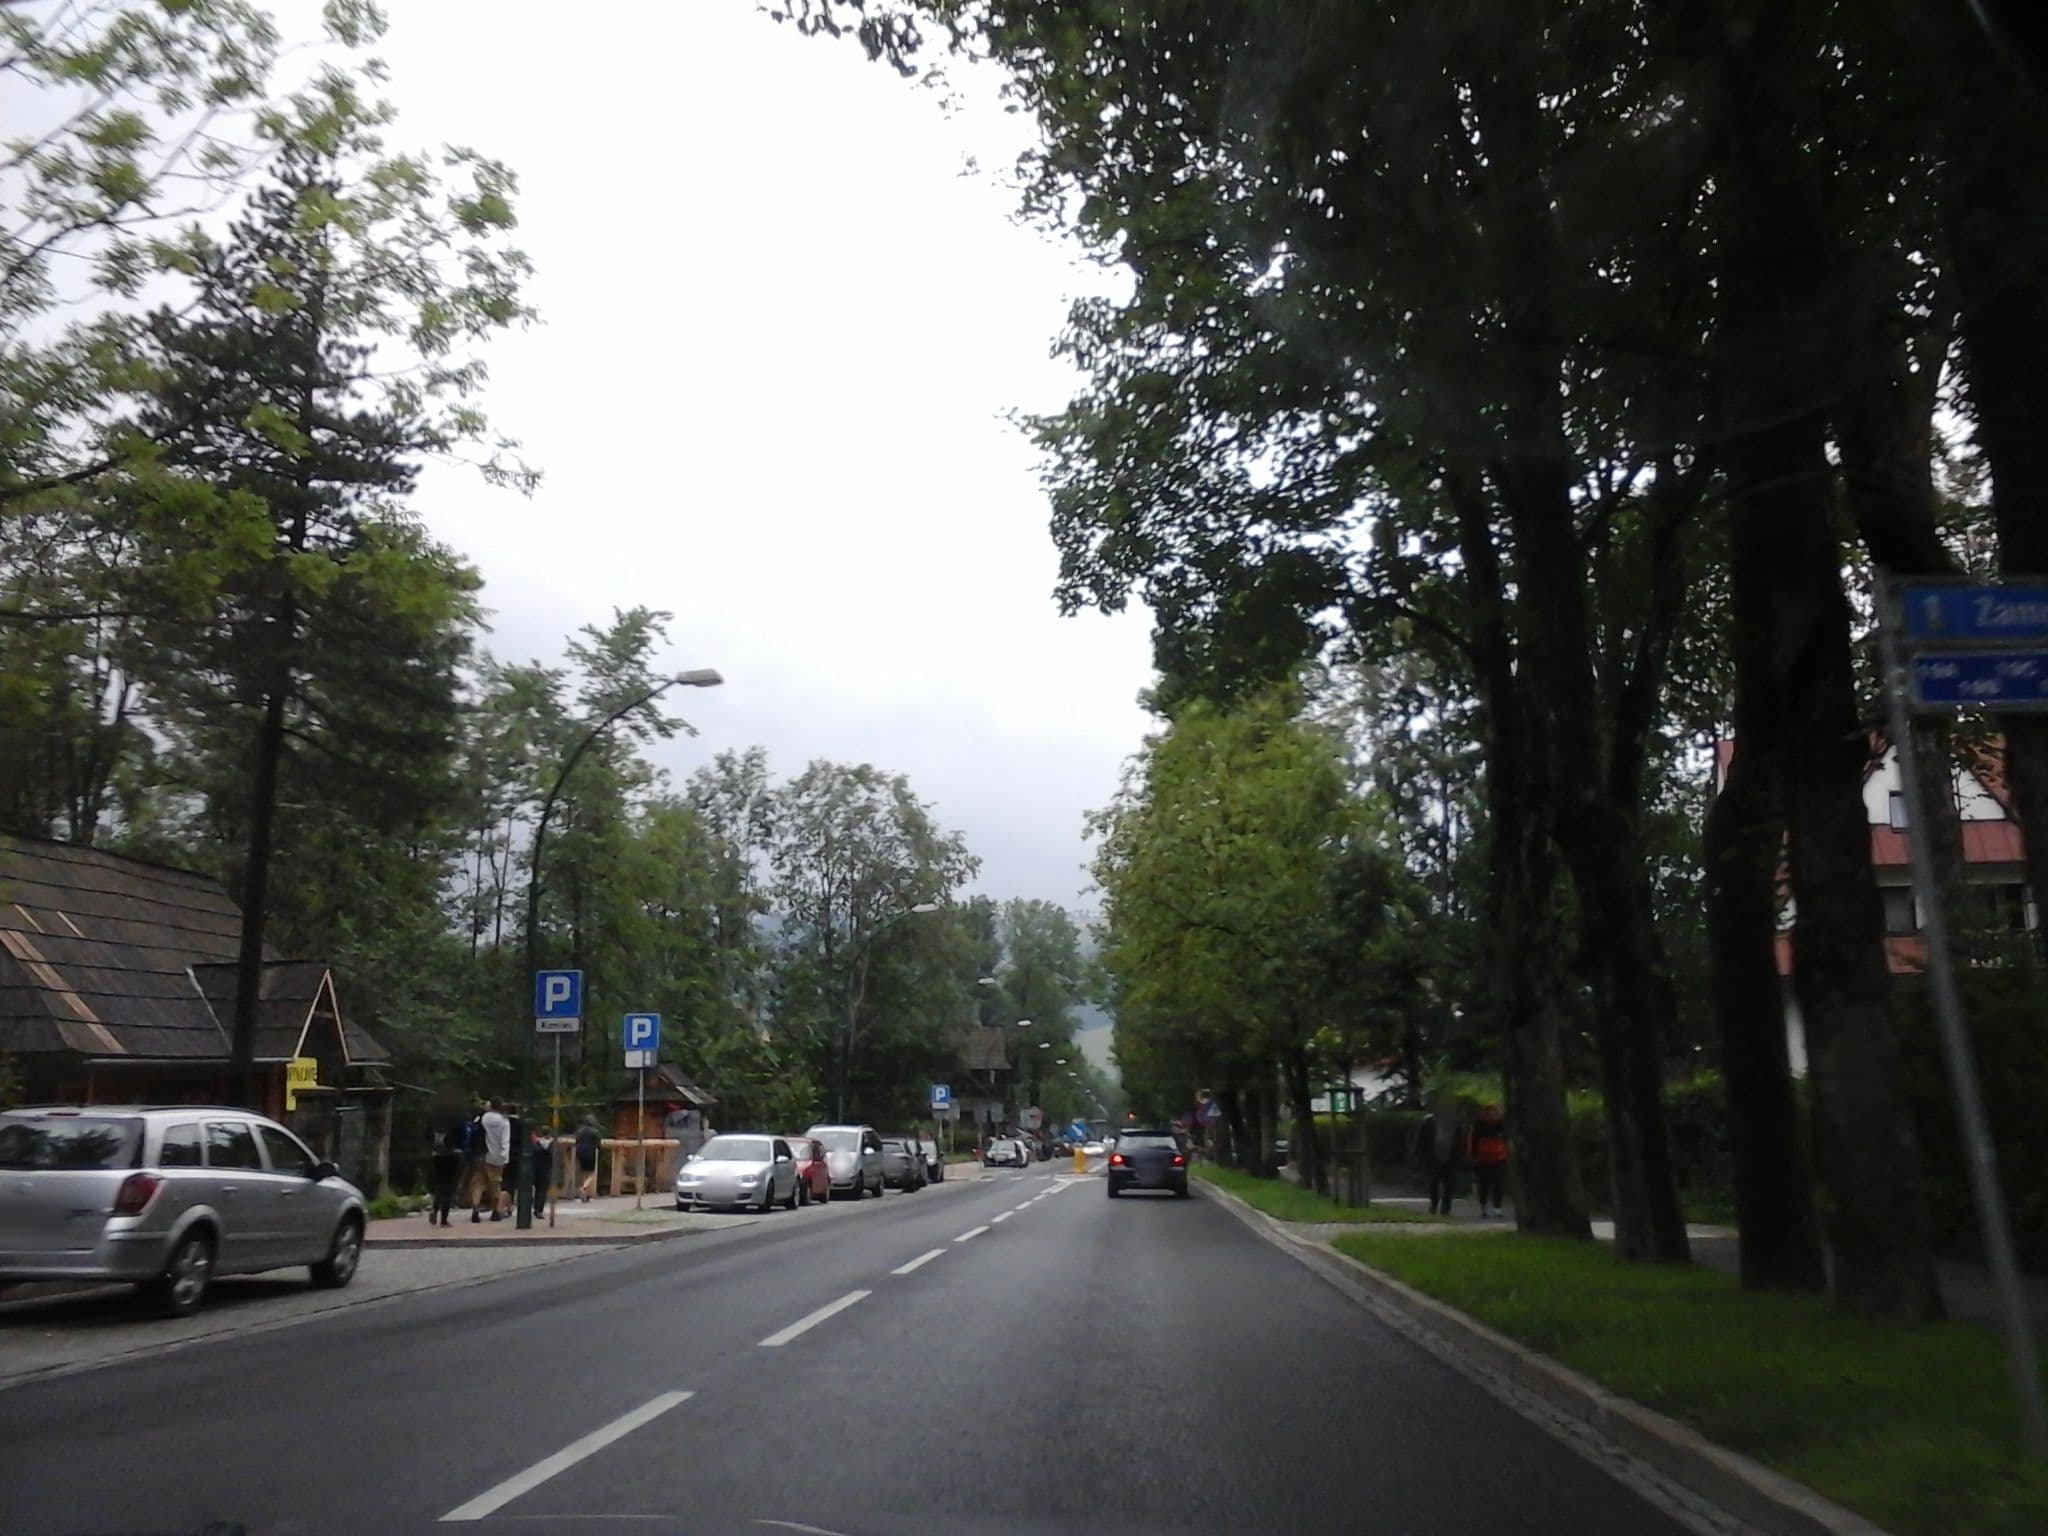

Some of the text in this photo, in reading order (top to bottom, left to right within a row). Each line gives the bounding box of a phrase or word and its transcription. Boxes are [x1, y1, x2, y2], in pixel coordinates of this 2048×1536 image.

[545, 975, 570, 1012] P
[632, 1018, 652, 1046] P
[935, 1086, 947, 1102] P
